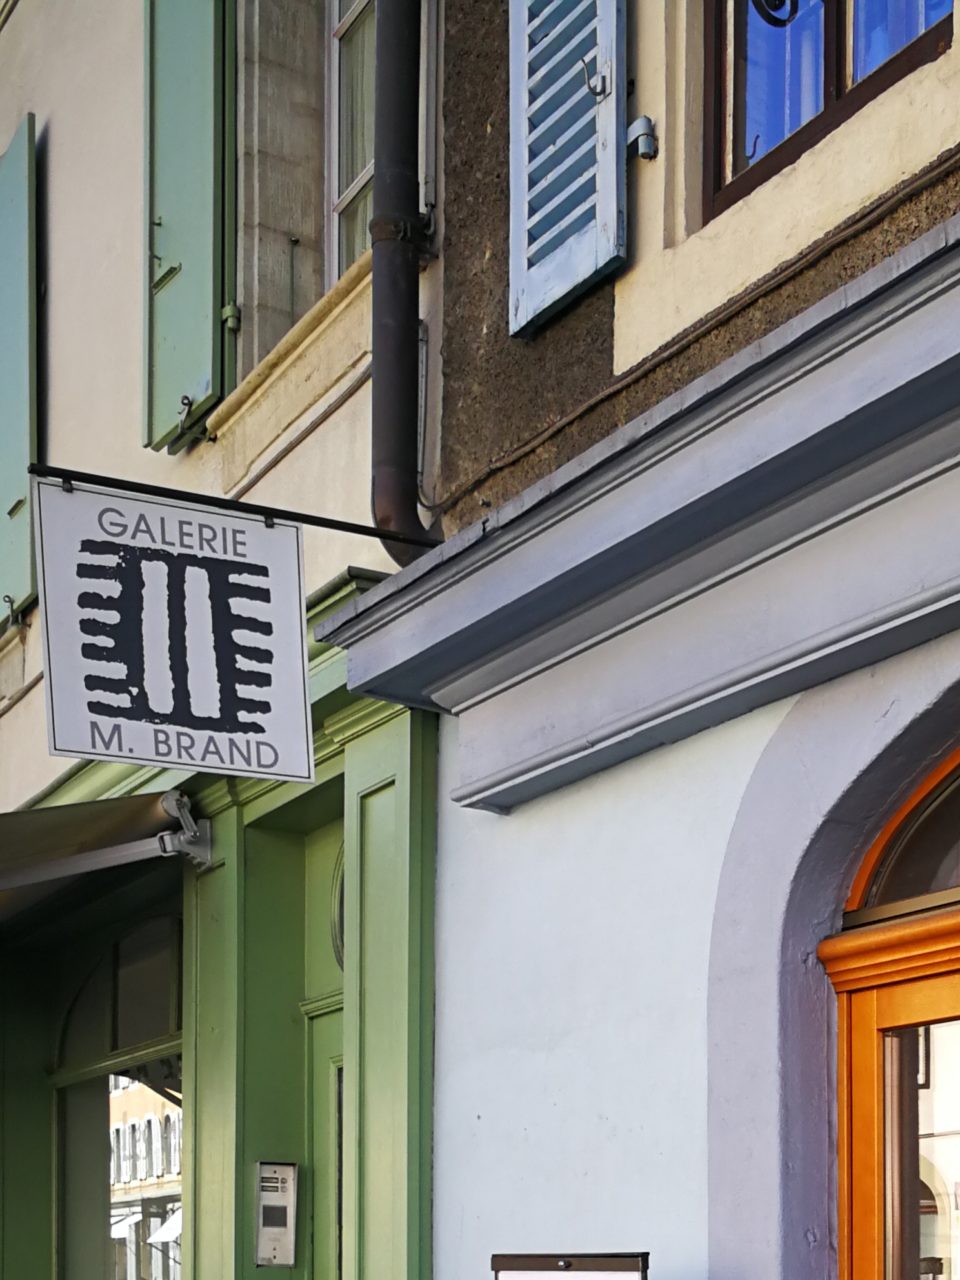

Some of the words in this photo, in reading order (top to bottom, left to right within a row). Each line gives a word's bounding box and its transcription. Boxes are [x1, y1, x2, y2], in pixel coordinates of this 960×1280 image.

[97, 507, 247, 558] GALERIE
[89, 720, 134, 754] M.
[153, 729, 279, 769] BRAND
